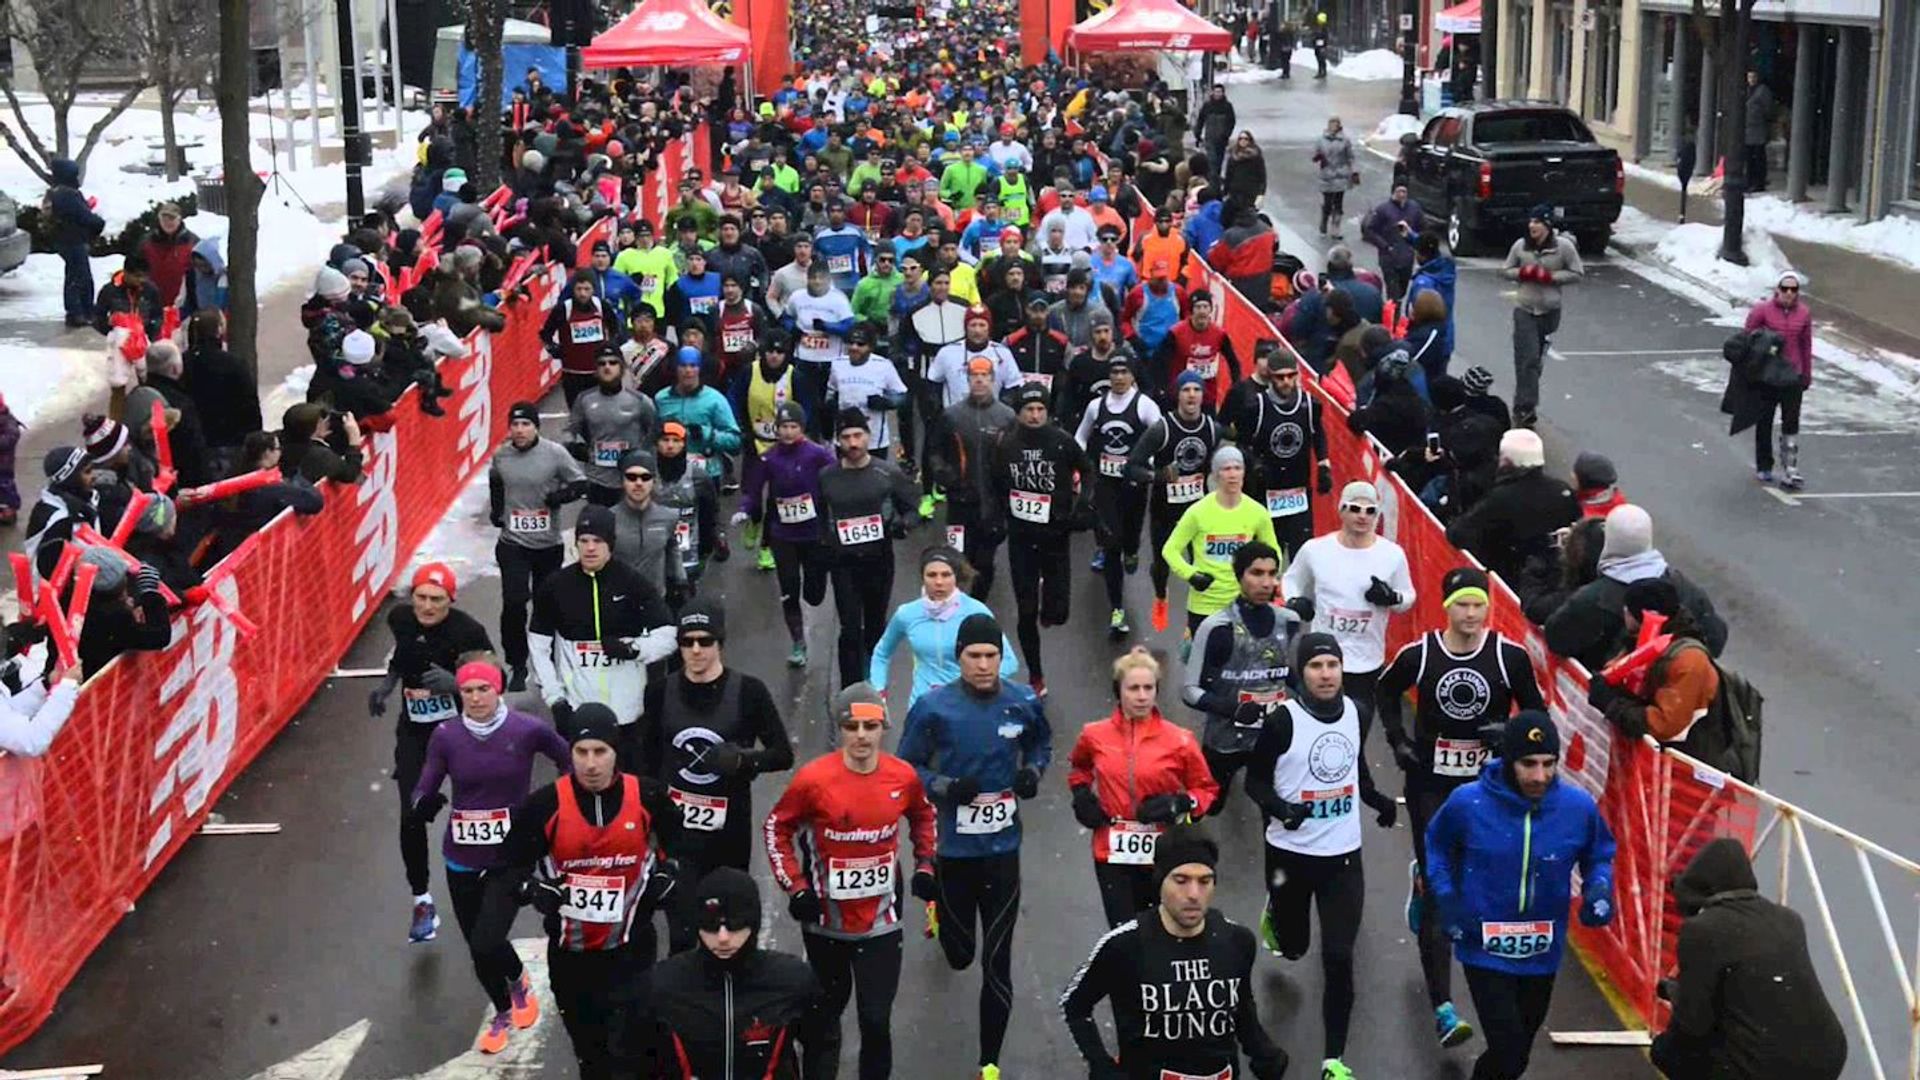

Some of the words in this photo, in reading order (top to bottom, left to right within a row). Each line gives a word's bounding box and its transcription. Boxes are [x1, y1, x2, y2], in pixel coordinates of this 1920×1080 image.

[1022, 449, 1043, 461] THE
[783, 503, 809, 518] 178
[1015, 499, 1042, 515] 312
[1270, 496, 1305, 511] 2280
[513, 517, 547, 531] 1633
[842, 524, 881, 543] 1649
[1328, 615, 1370, 634] 1327
[580, 651, 625, 667] 173
[1439, 671, 1462, 698] BLACK
[1462, 671, 1487, 698] LUNGS
[410, 694, 452, 715] 2036
[1312, 737, 1332, 762] BLACK
[1439, 749, 1489, 768] 1192
[968, 802, 1008, 824] 793
[1303, 795, 1353, 819] 2146
[457, 820, 506, 841] 1434
[823, 828, 881, 844] running
[1114, 833, 1161, 854] 166
[563, 854, 615, 869] running
[614, 852, 638, 866] free
[836, 865, 889, 890] 1239
[563, 886, 620, 911] 1347
[1487, 934, 1549, 955] 2356
[1170, 958, 1212, 982] THE
[1140, 977, 1241, 1012] BLACK
